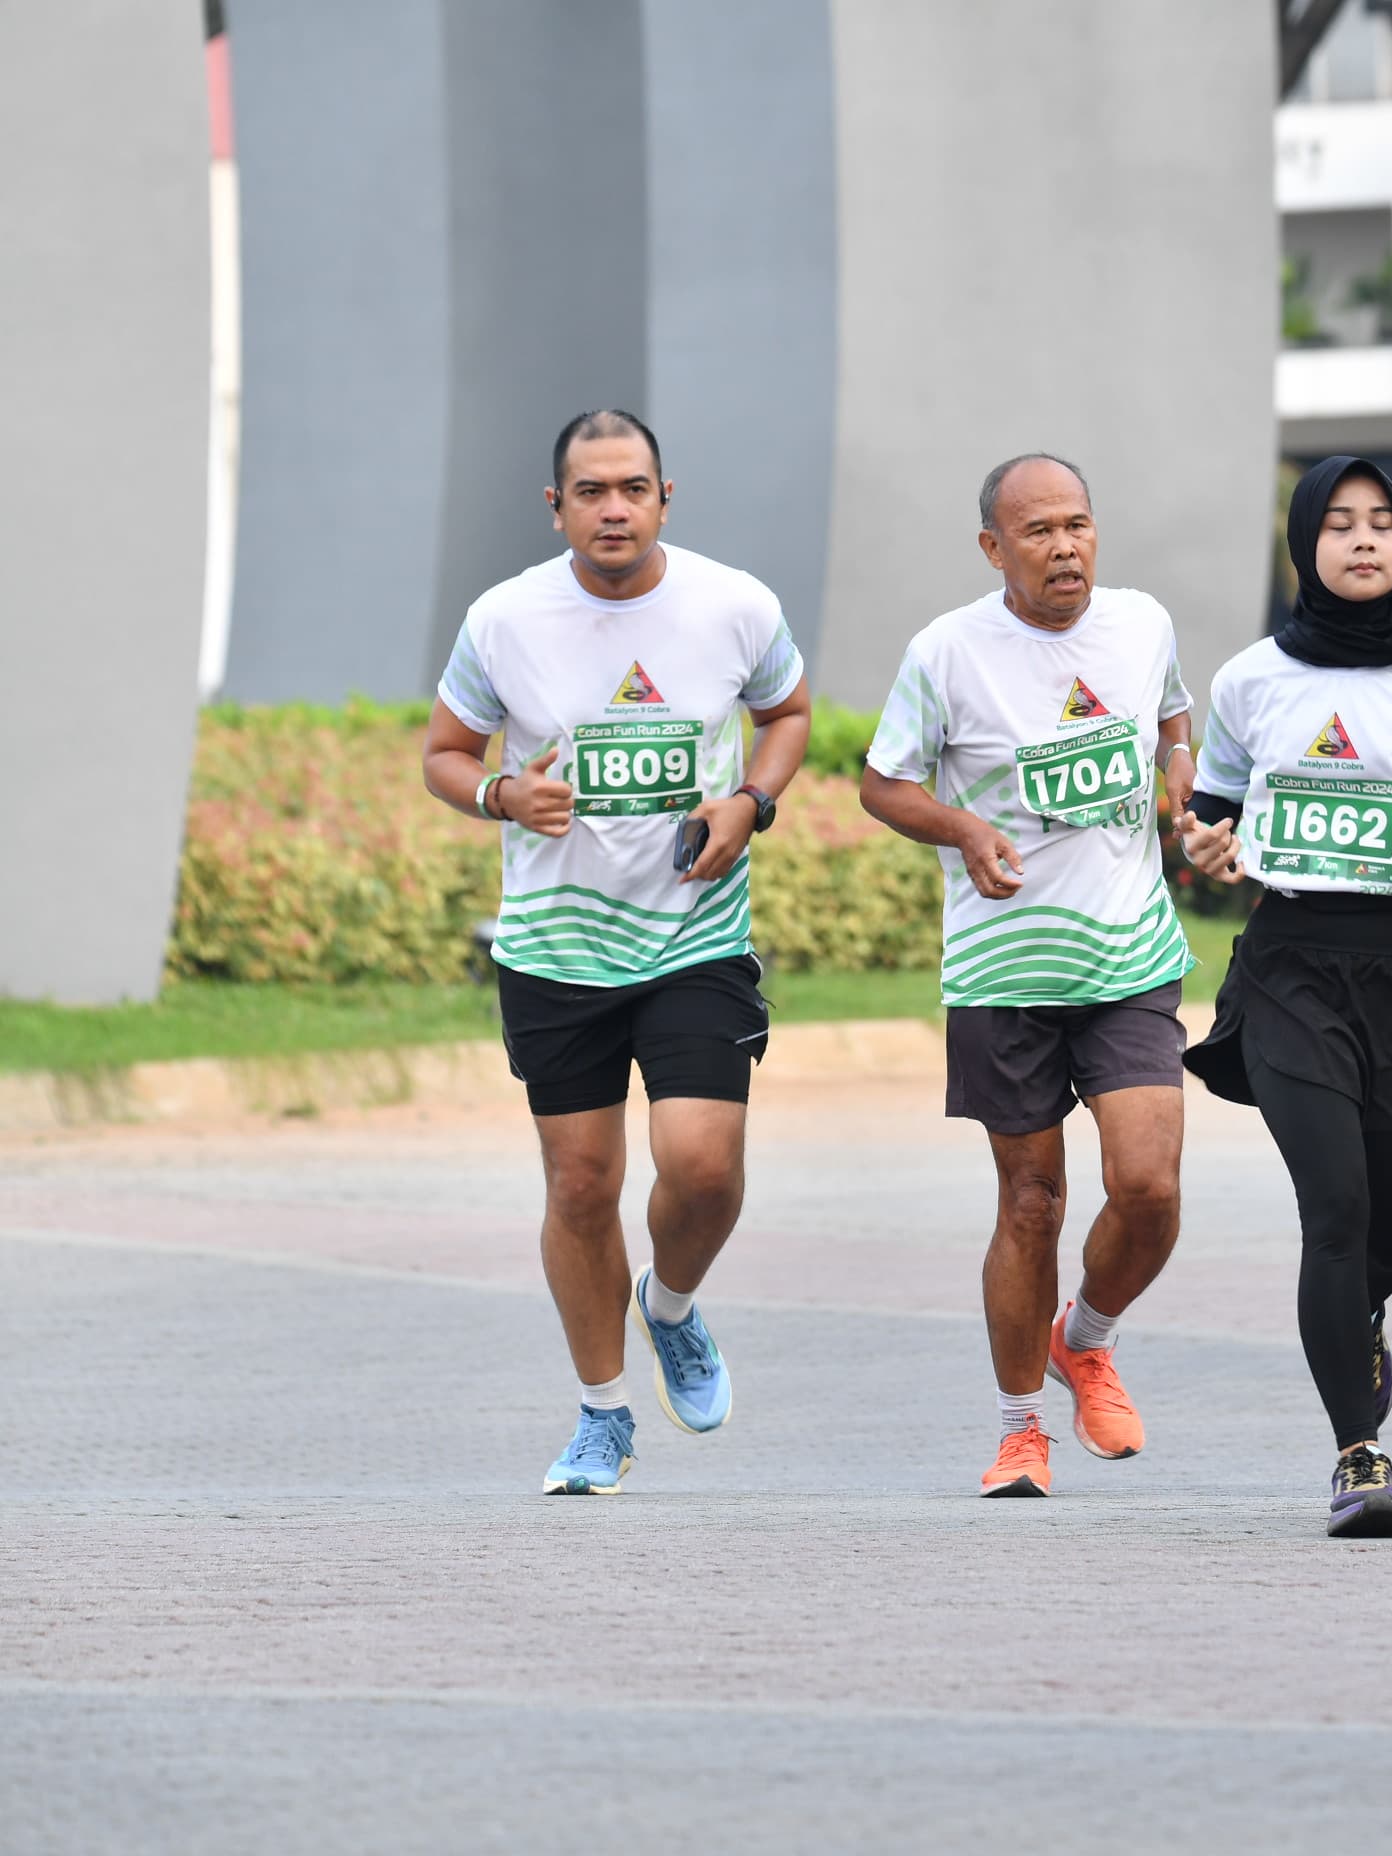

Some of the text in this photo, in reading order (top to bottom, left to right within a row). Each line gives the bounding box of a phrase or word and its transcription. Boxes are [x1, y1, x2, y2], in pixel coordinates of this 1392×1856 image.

[578, 723, 694, 738] Cobra Fun Run 2024
[1022, 725, 1129, 760] Cobra Fun Run 2024
[583, 747, 689, 787] 1809
[1030, 751, 1134, 806] 1704
[1298, 759, 1365, 771] Batalyon 9 Cobra
[1274, 776, 1310, 789] Cobra
[1311, 779, 1334, 791] Fun
[1335, 781, 1361, 793] Run
[1282, 799, 1389, 850] 1662
